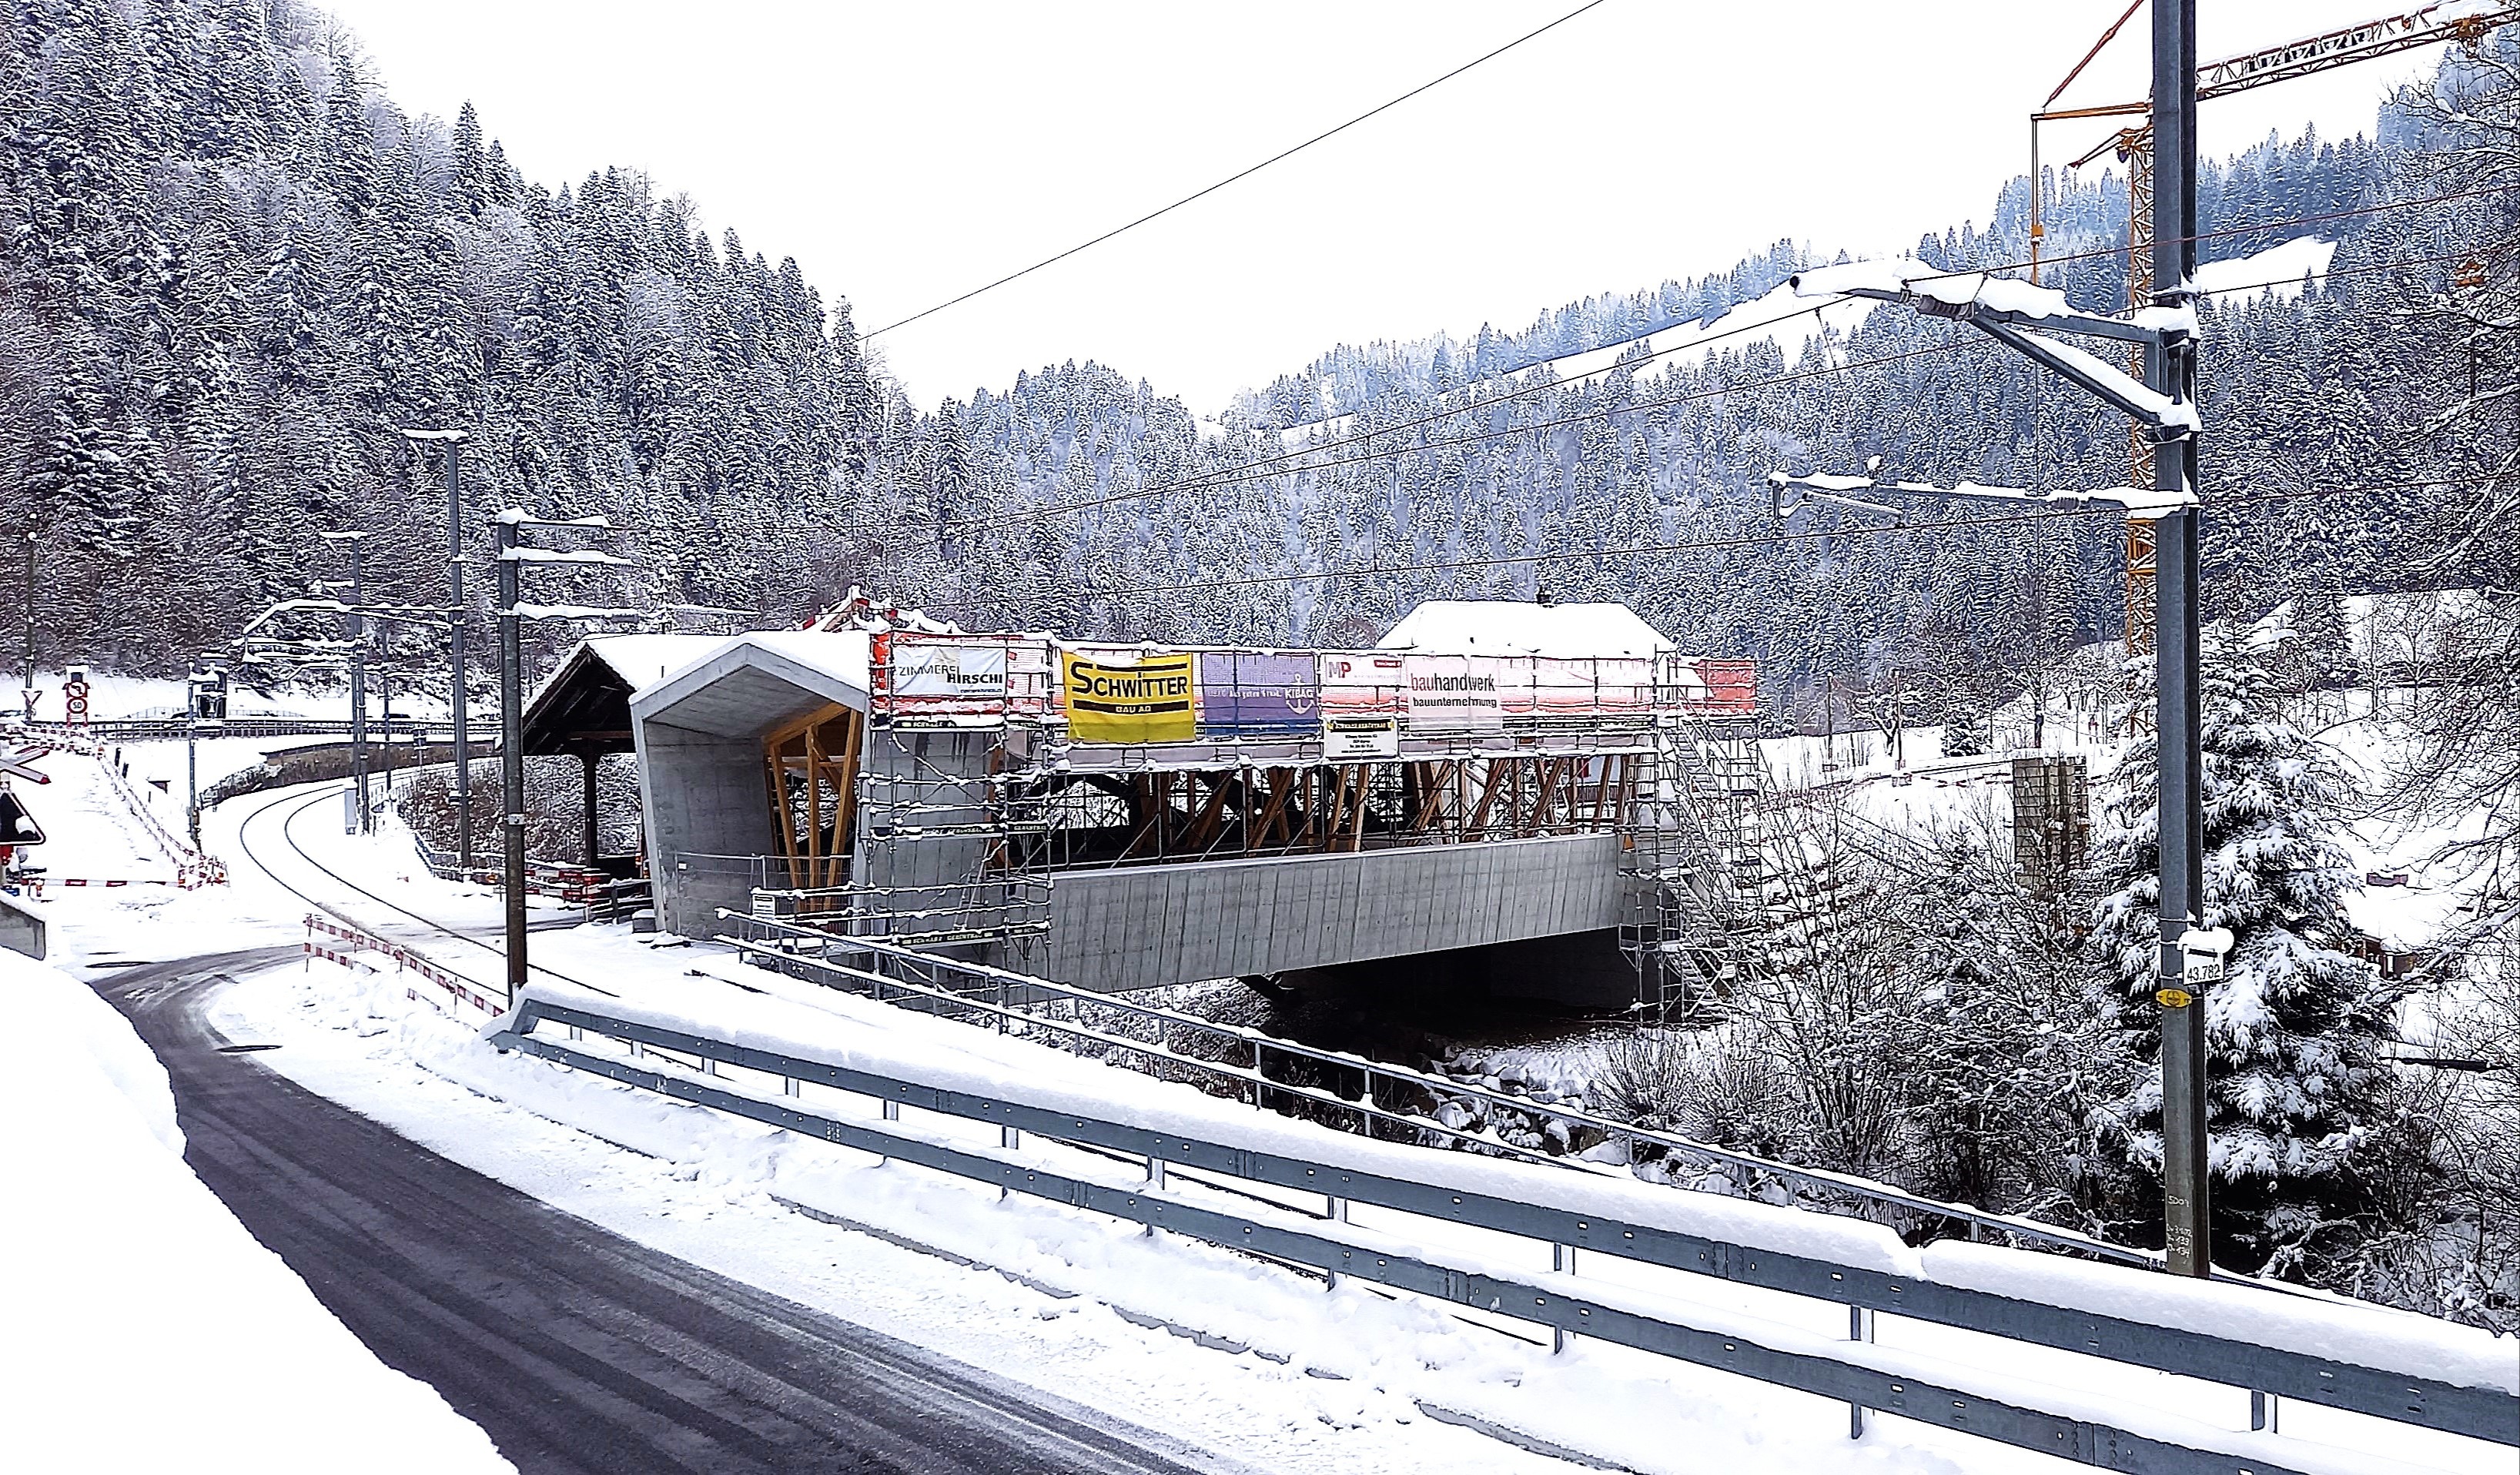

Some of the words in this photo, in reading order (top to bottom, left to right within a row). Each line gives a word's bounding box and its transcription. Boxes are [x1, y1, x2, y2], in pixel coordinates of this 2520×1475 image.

[899, 664, 959, 676] ZIMMEREI
[1328, 662, 1351, 678] MP
[947, 674, 1003, 684] HIRSCHI
[1411, 673, 1495, 691] bauhandwerk
[1285, 687, 1314, 699] KIBAG
[1412, 697, 1498, 708] bauunternehmung
[2187, 963, 2221, 982] 43.782
